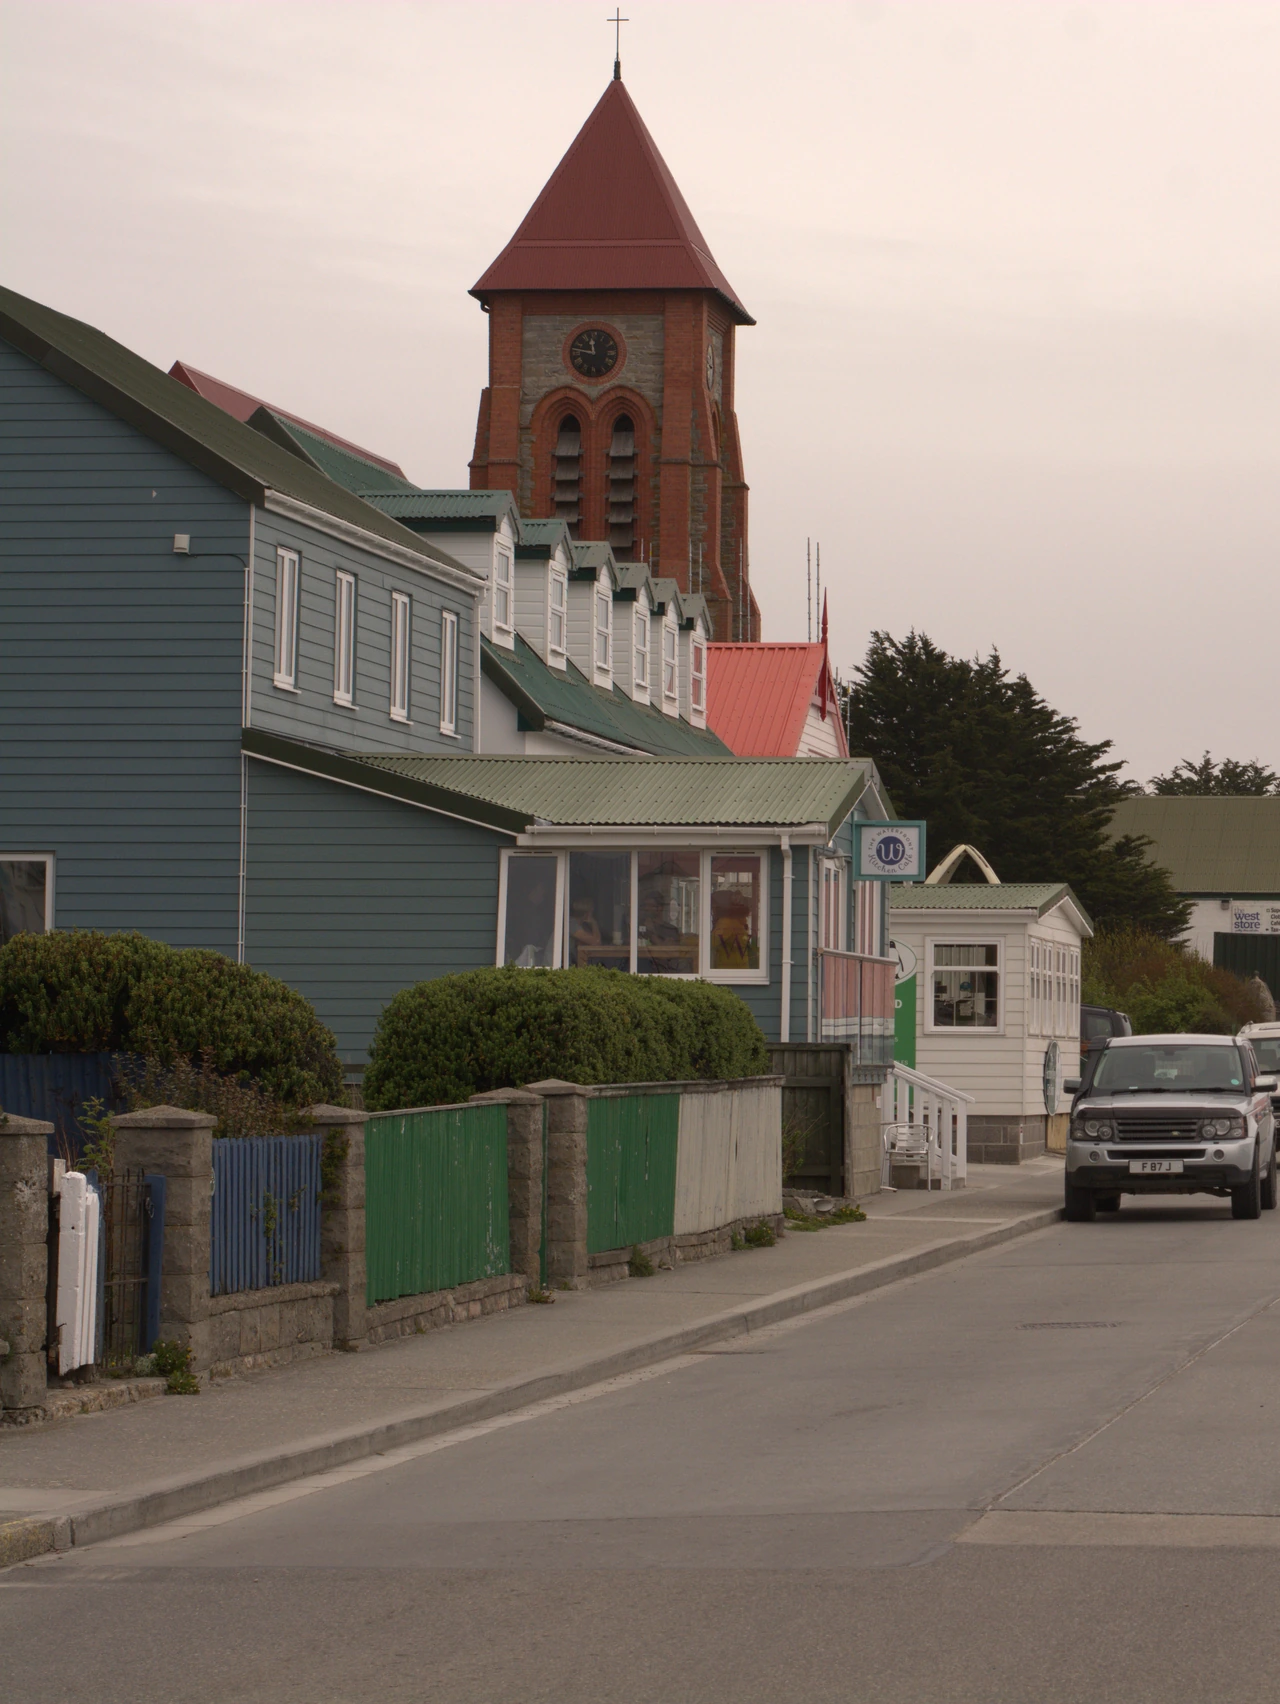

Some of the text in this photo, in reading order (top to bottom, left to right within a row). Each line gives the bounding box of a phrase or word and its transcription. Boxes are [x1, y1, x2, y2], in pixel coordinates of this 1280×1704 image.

[868, 828, 913, 850] THE WATERFRONT
[868, 854, 913, 873] Kitchen Café
[1234, 912, 1260, 921] west
[1234, 920, 1261, 929] store
[718, 934, 752, 960] W
[1141, 1162, 1171, 1171] F 87 J
